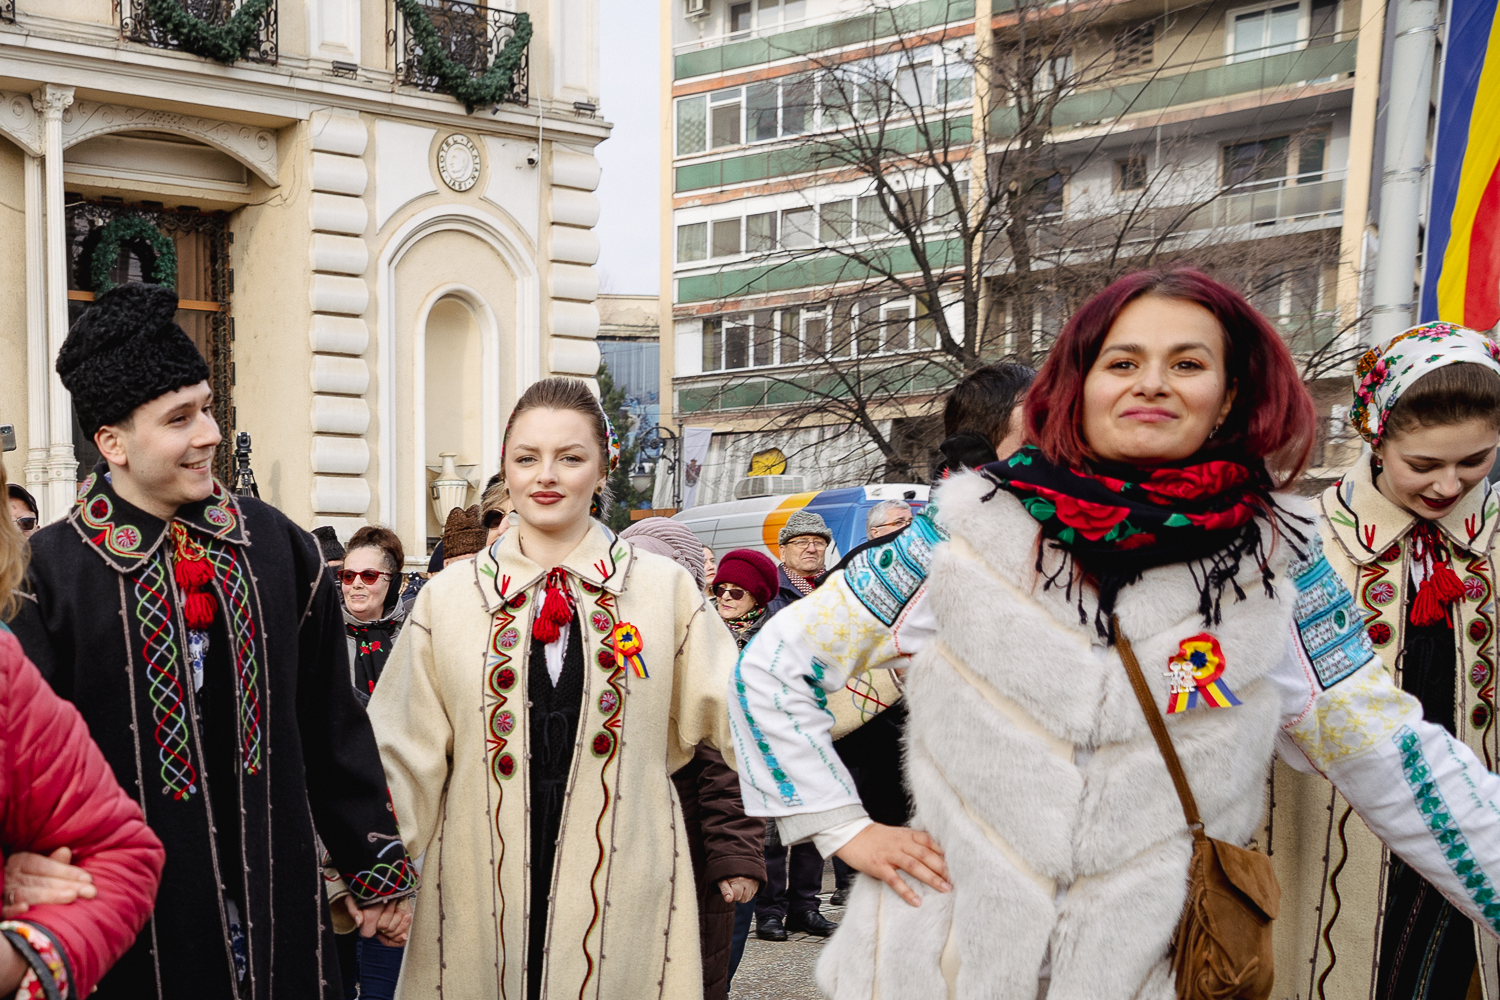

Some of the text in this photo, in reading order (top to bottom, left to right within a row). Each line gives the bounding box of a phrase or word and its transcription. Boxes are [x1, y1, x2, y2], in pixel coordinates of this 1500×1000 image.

[439, 137, 479, 190] HOTEL TRAIAN IASI
